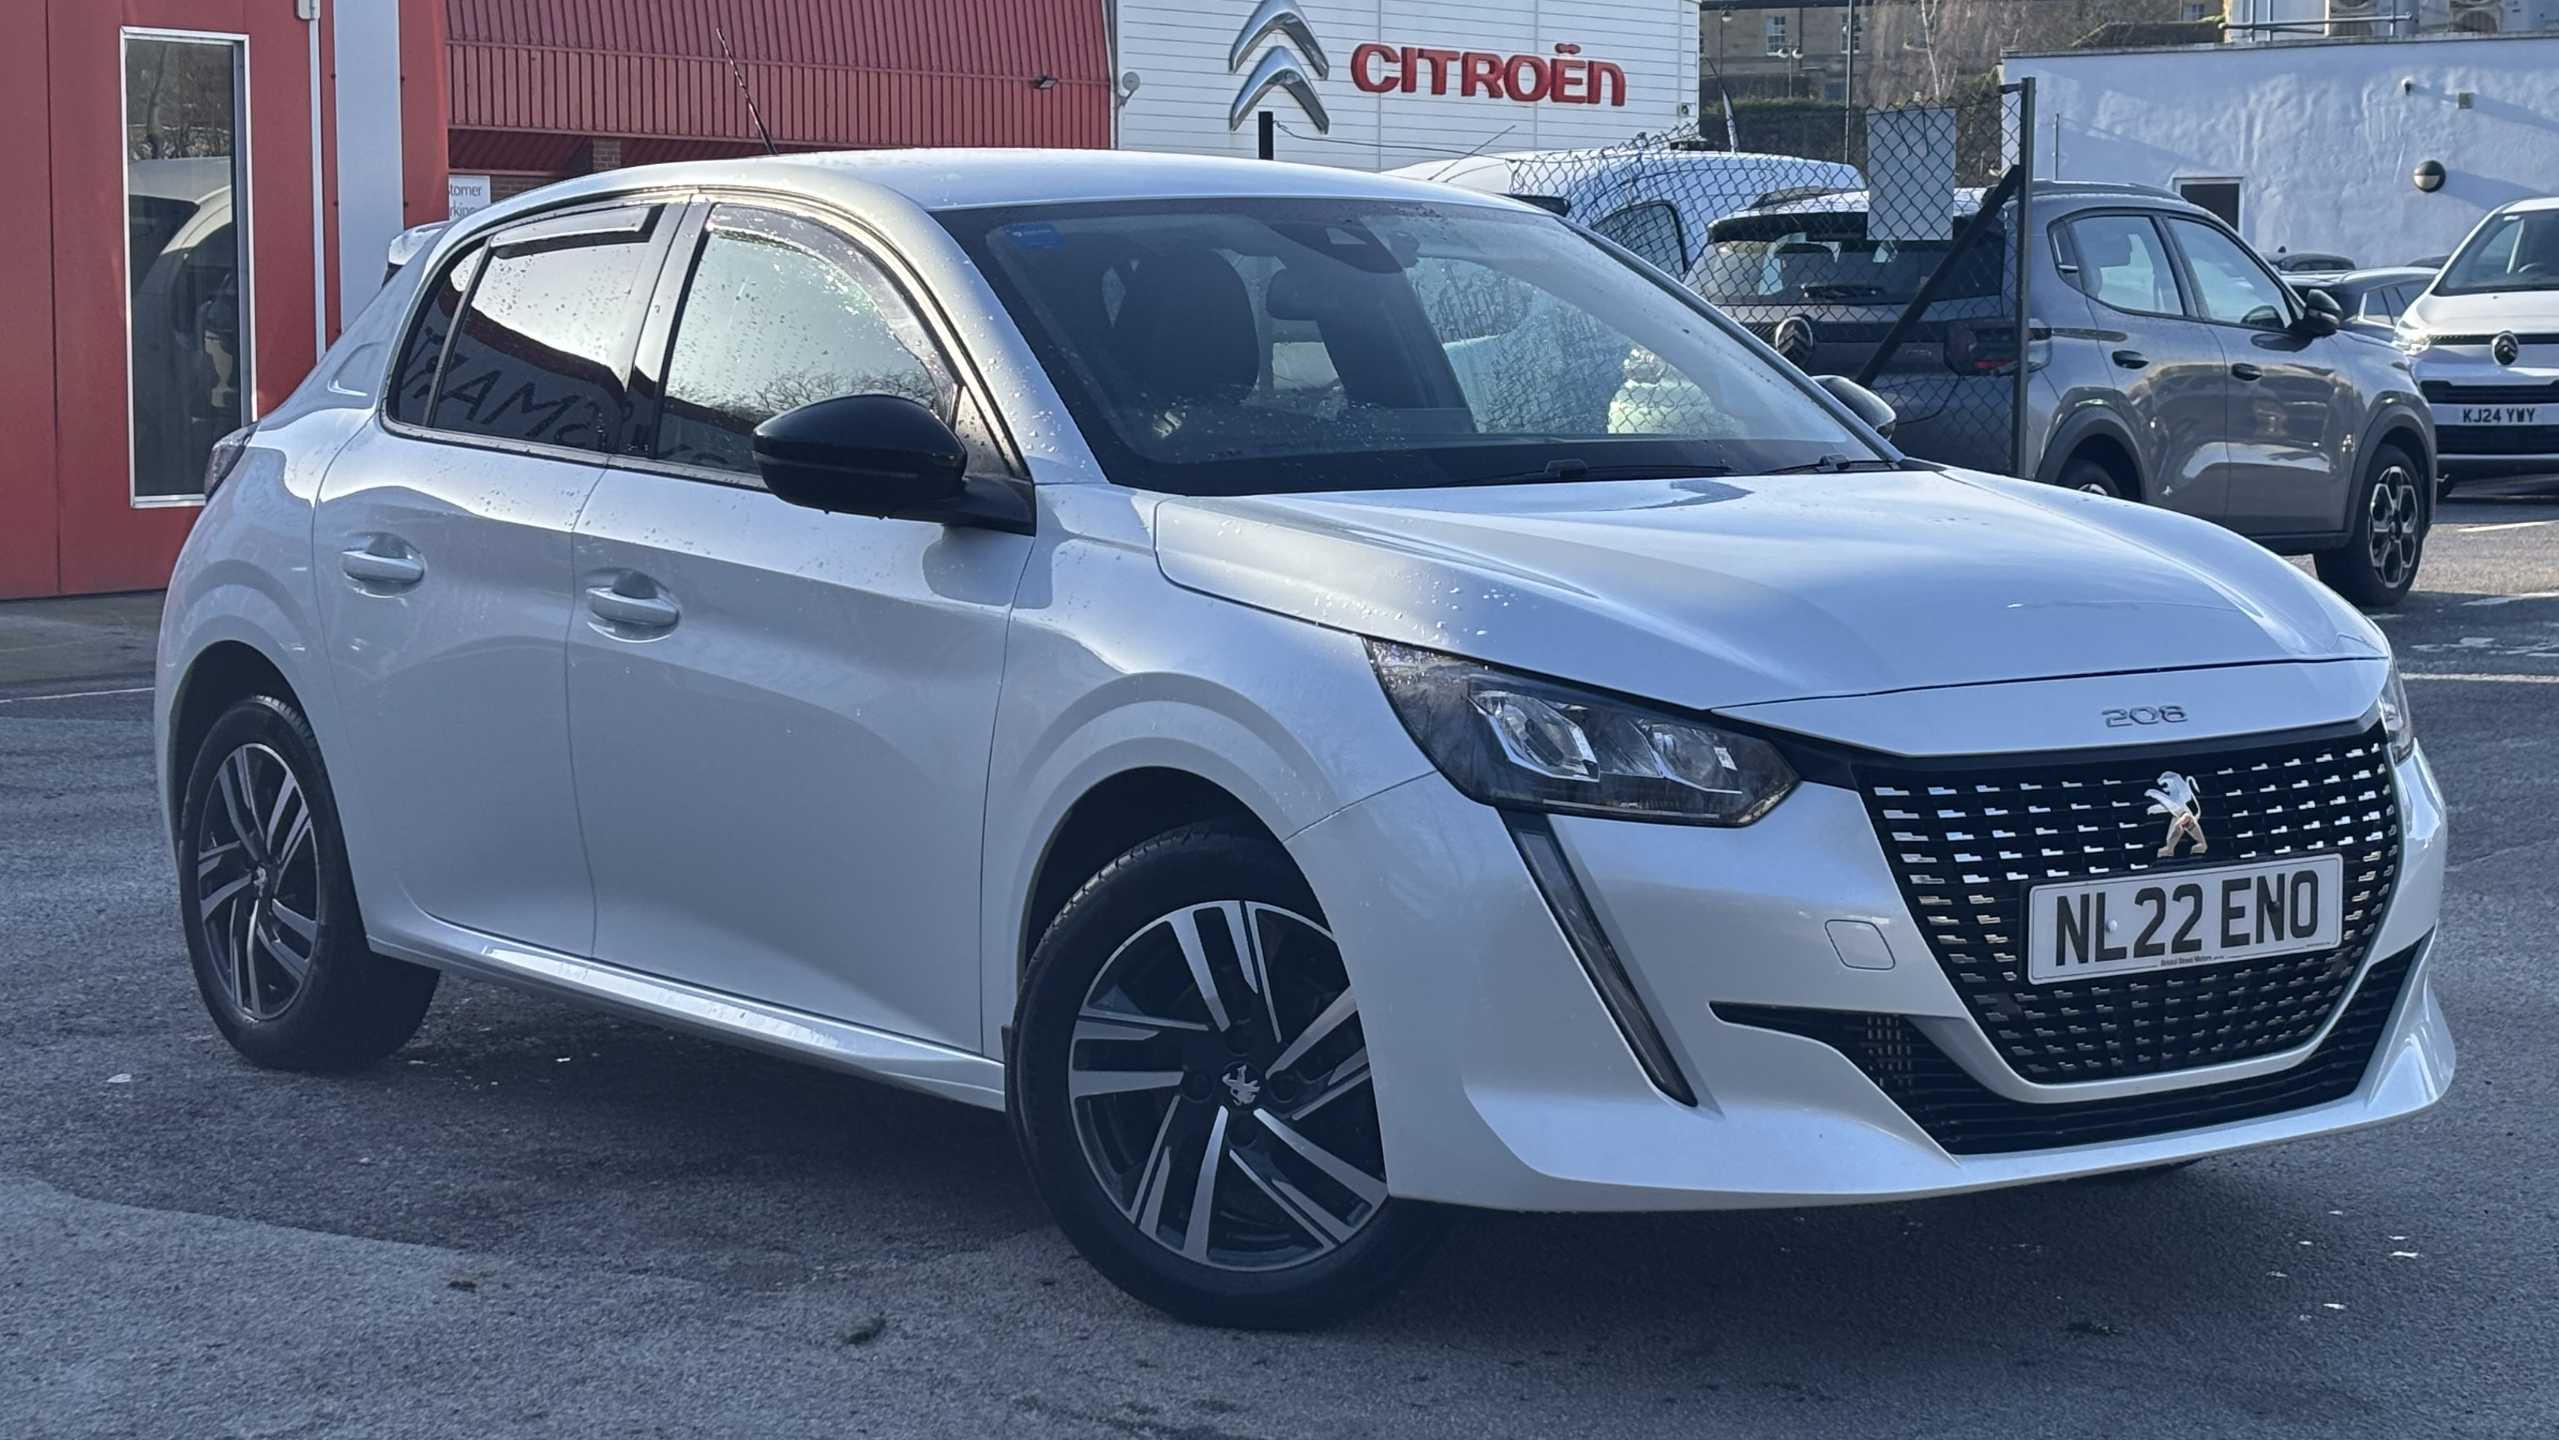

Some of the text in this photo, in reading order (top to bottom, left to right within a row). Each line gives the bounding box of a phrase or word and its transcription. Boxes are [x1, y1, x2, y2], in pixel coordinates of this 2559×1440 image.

[450, 184, 481, 197] tomer
[2463, 407, 2536, 423] KJ24 YWY
[2102, 705, 2188, 728] 208
[2055, 869, 2319, 967] NL22 ENO
